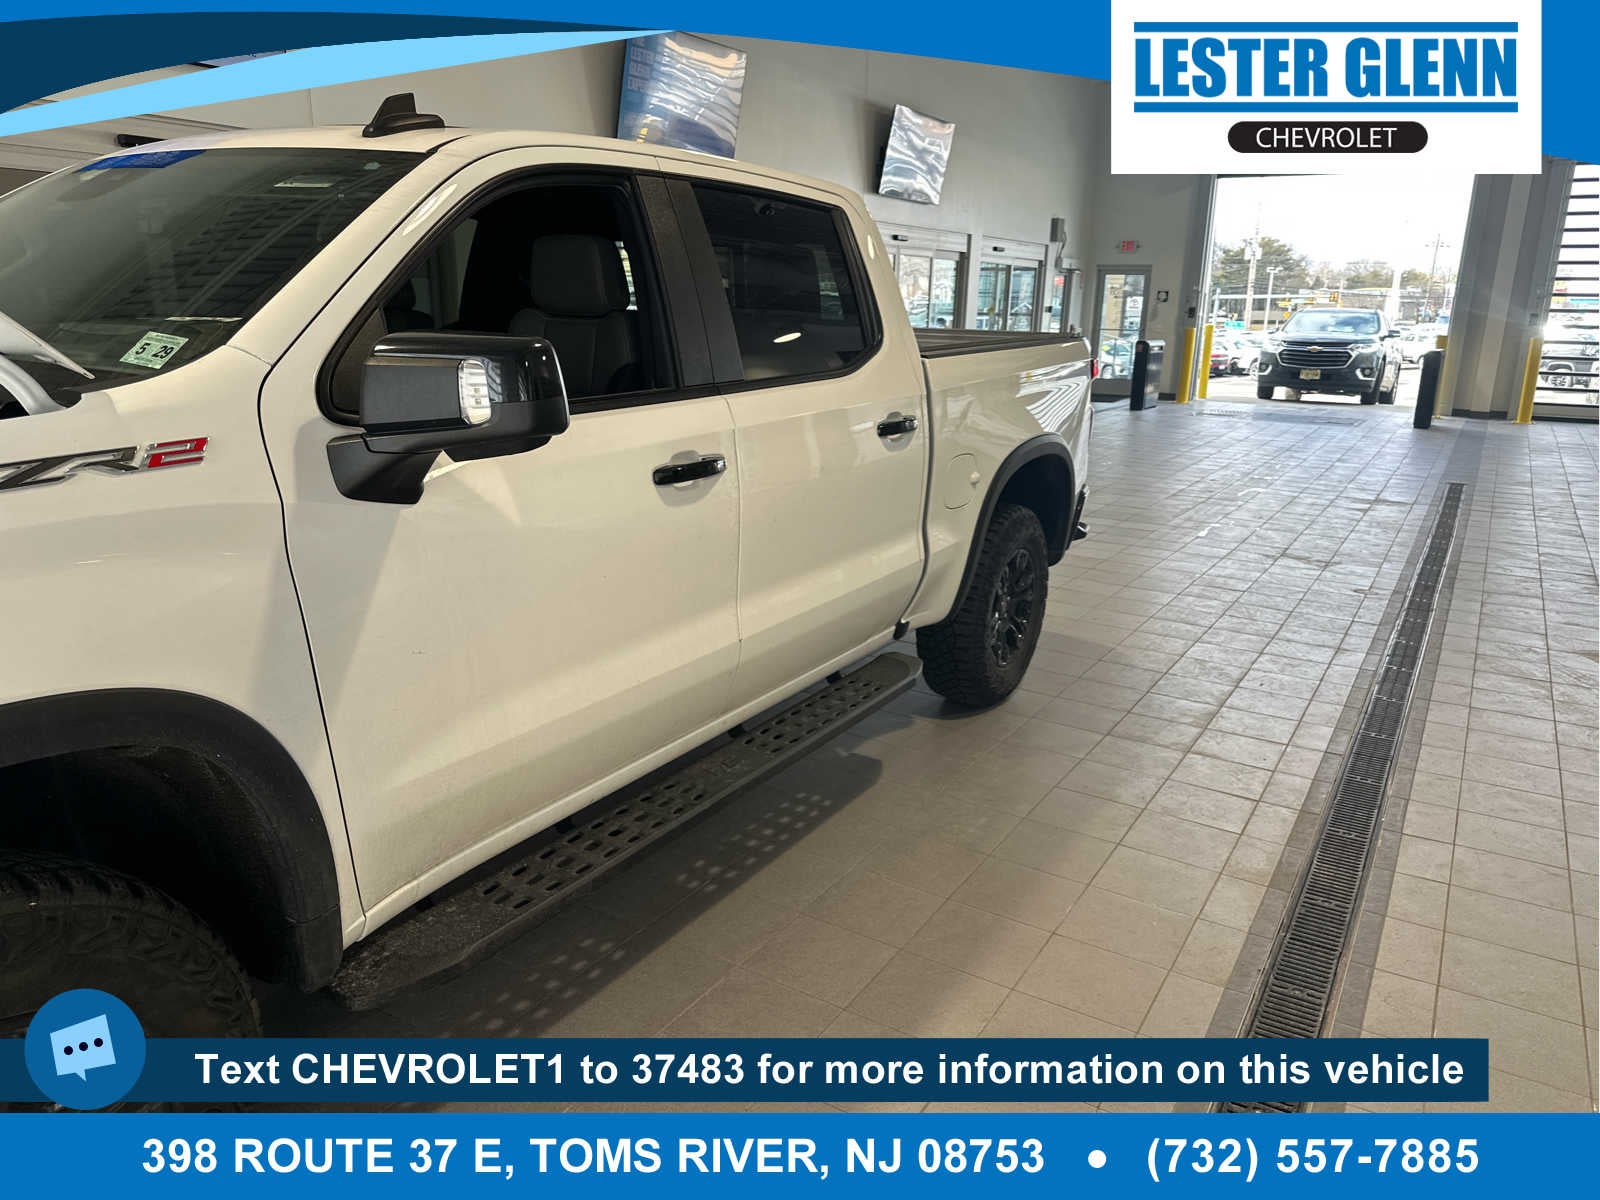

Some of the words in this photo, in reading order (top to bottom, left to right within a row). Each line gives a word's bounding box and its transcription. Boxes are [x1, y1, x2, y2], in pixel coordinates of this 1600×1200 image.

[135, 342, 151, 355] 5
[152, 345, 175, 359] 29
[0, 436, 210, 493] ZR2
